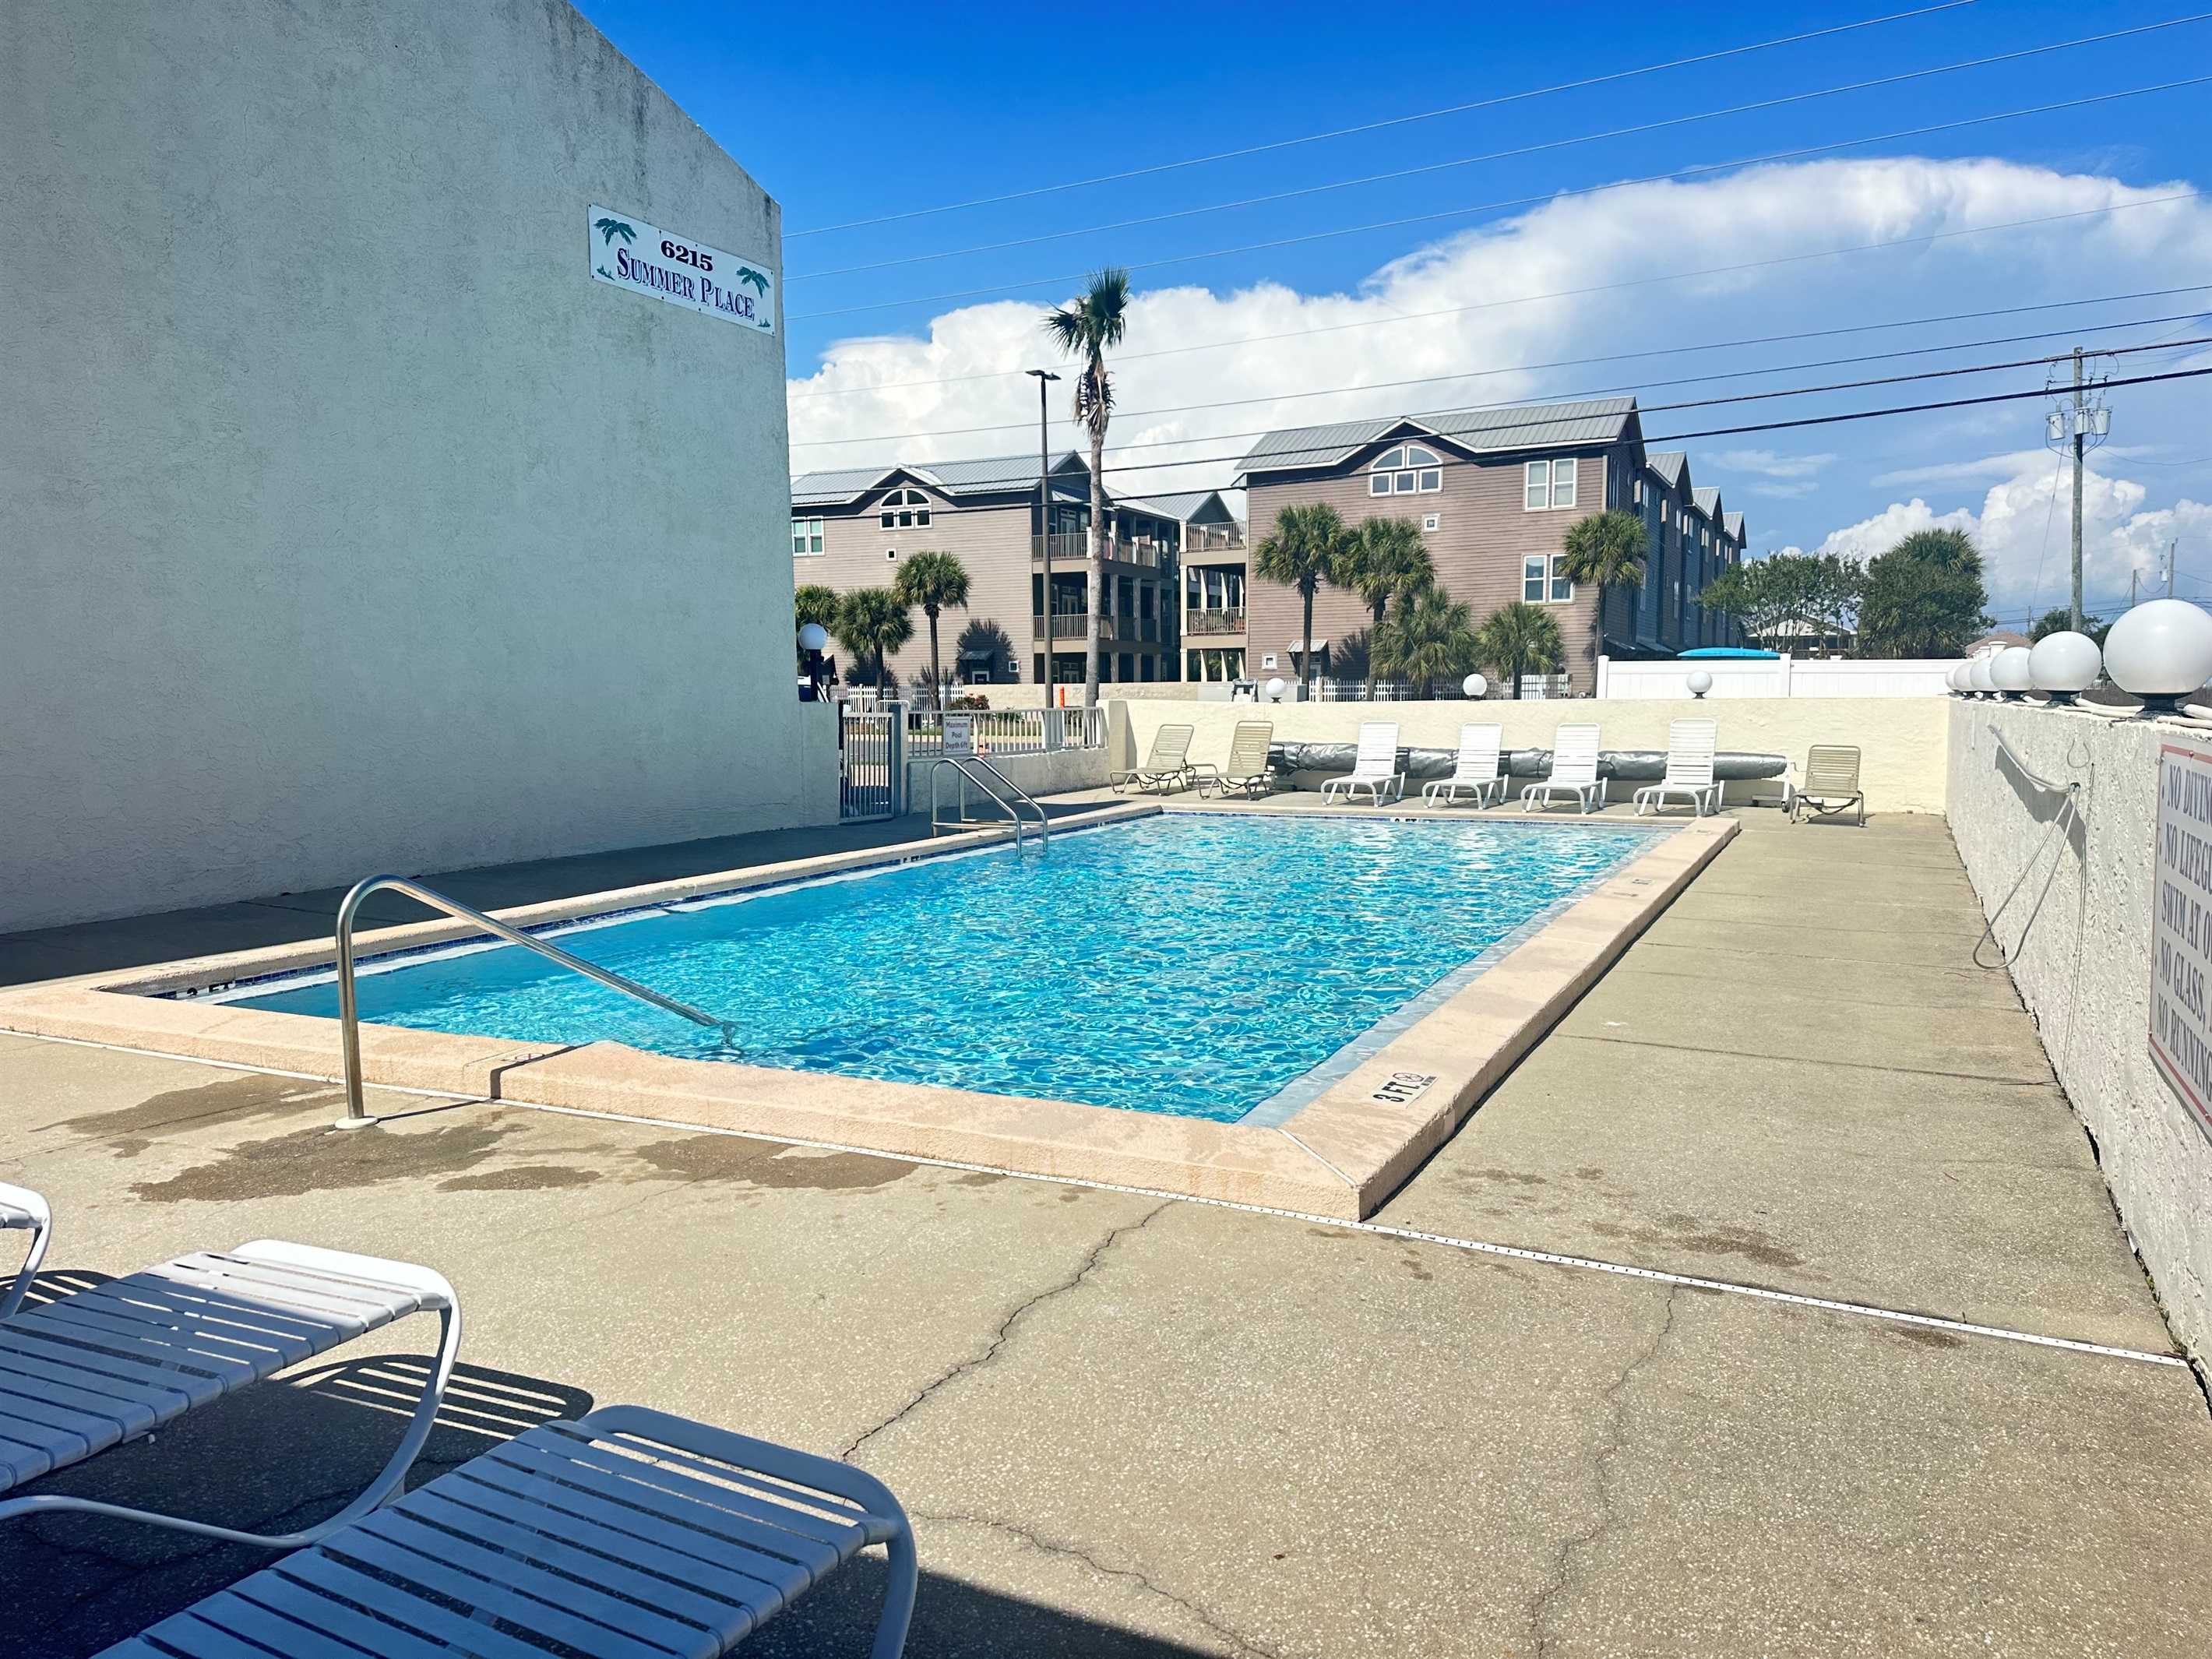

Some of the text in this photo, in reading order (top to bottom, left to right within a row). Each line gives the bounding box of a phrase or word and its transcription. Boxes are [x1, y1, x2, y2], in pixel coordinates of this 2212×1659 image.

[660, 240, 713, 272] 6215
[617, 248, 756, 322] SUMMER PLACE
[946, 741, 960, 750] Depth
[2168, 764, 2212, 828] NO DIVIN
[2165, 822, 2178, 870] NO
[2161, 879, 2212, 964] SWIM AT O
[2160, 936, 2171, 986] NO
[2157, 992, 2168, 1043] NO
